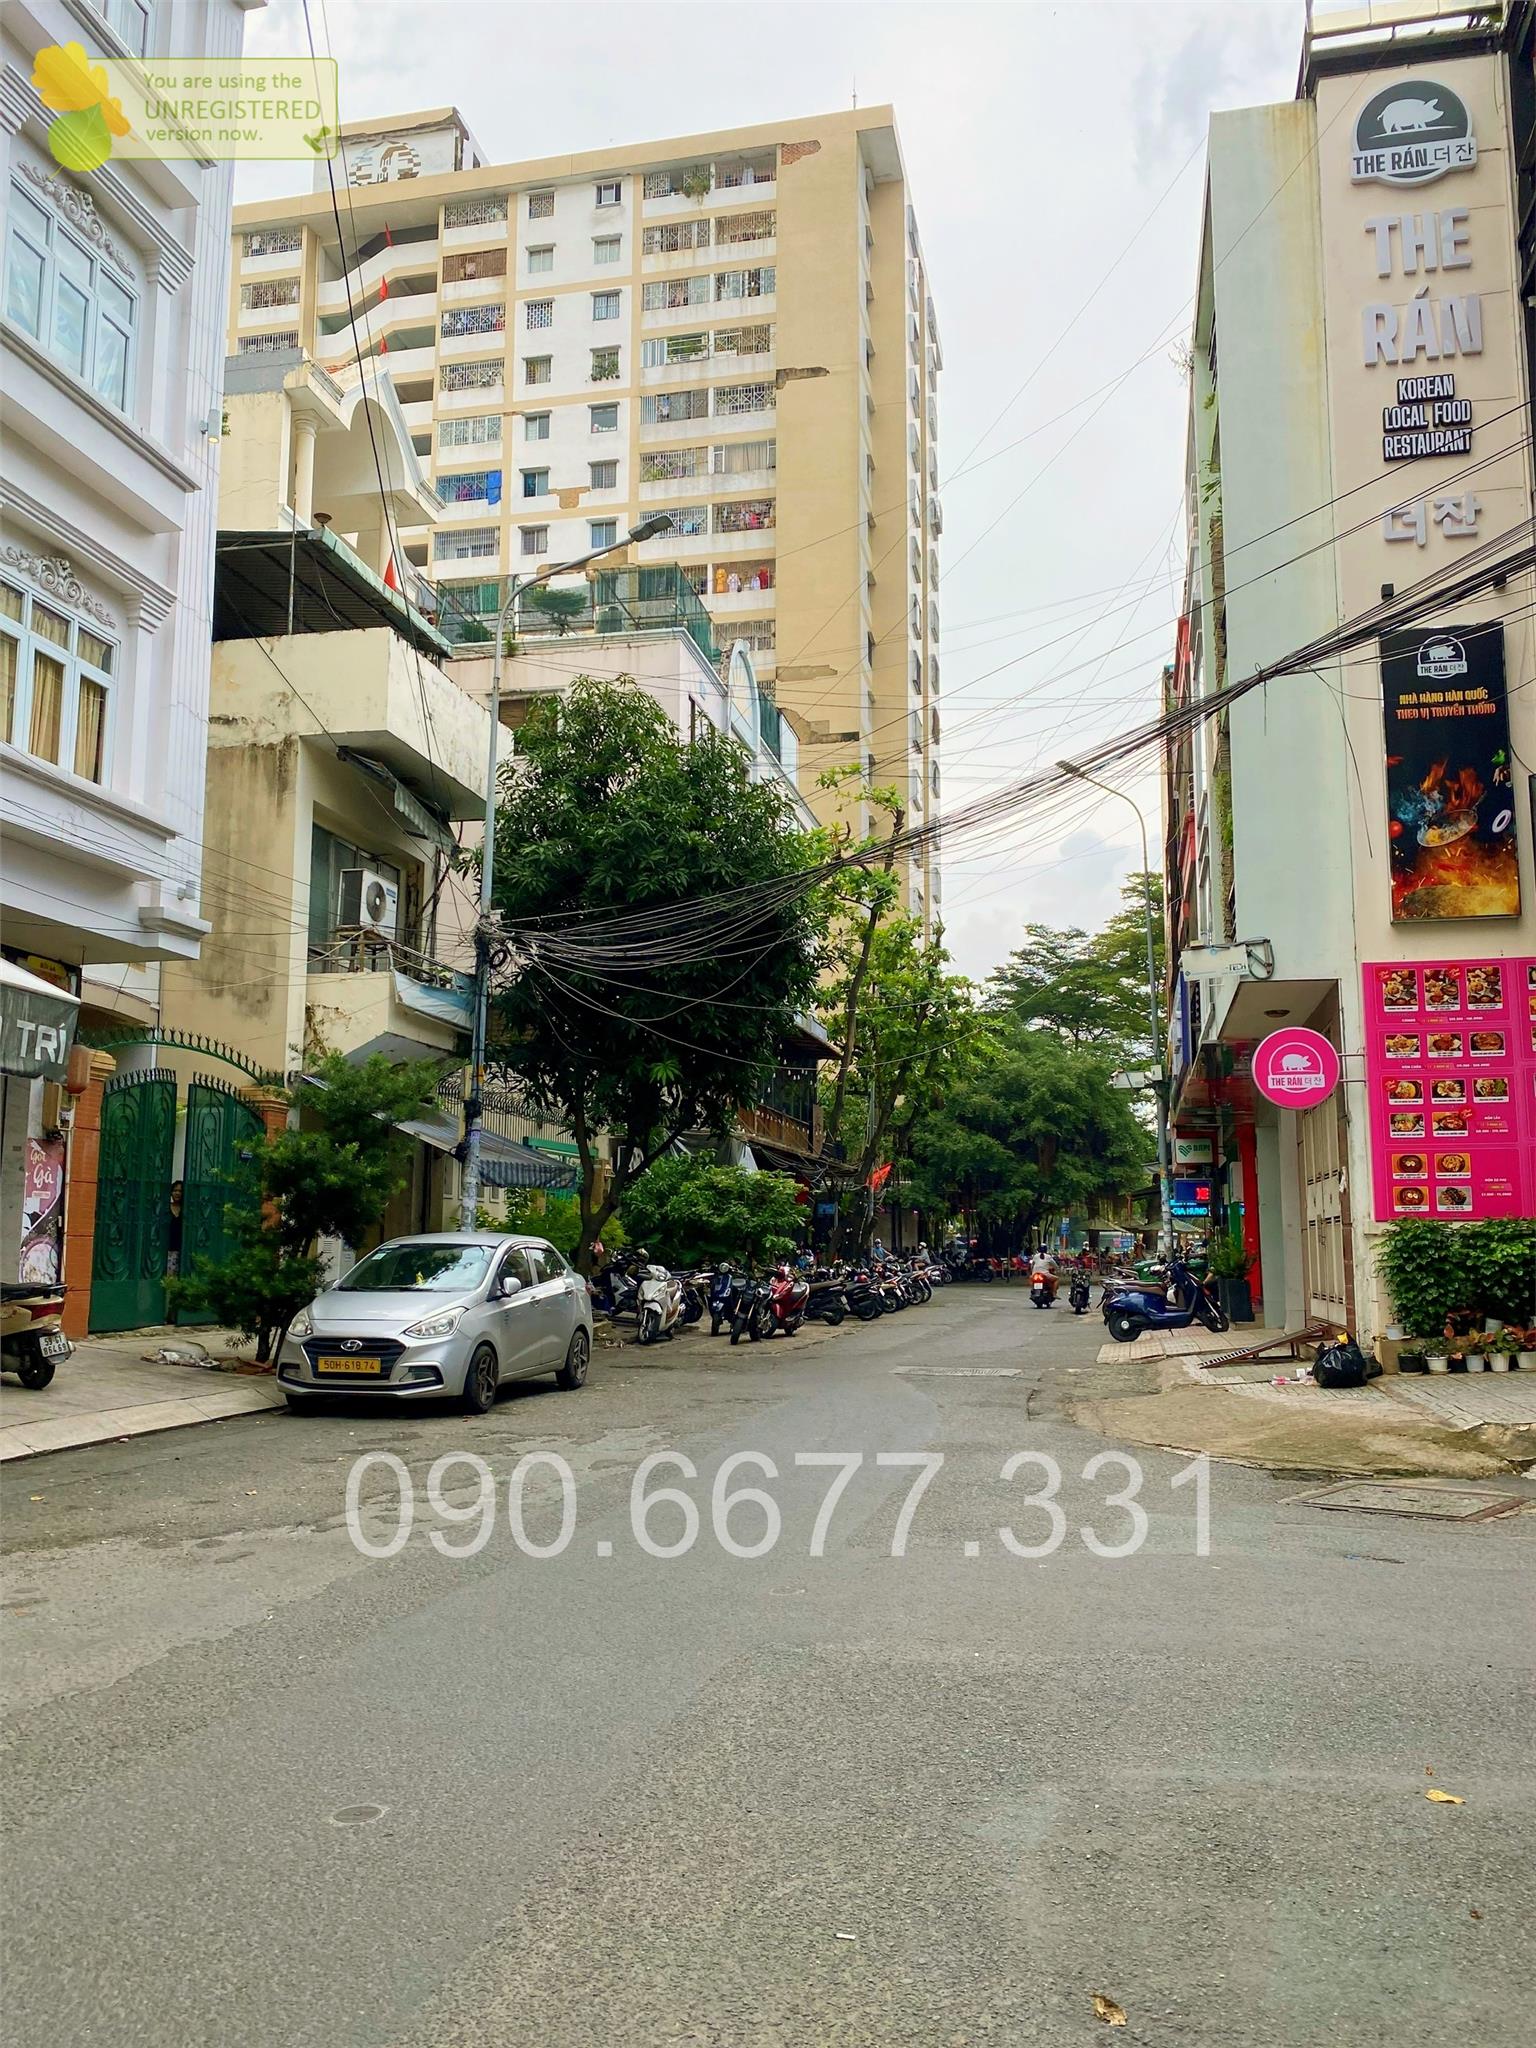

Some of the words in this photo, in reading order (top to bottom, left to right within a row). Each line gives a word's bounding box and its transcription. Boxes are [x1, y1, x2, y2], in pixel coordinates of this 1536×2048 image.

[1353, 153, 1386, 175] THE
[1364, 206, 1472, 278] THE
[1361, 284, 1484, 367] RÁN
[1398, 374, 1454, 401] KOREAN
[1383, 405, 1428, 430] LOCAL
[1432, 401, 1472, 425] FOOD
[1383, 428, 1472, 458] RESTAURANT
[1420, 666, 1432, 674] THE
[1399, 692, 1418, 705] NHÀ
[1420, 691, 1444, 704] HÀNG
[1445, 689, 1464, 702] HÀN
[1465, 686, 1489, 701] QUỐC
[1396, 708, 1419, 720] THEO
[16, 1019, 67, 1065] TRÍ
[1271, 1076, 1286, 1087] THE
